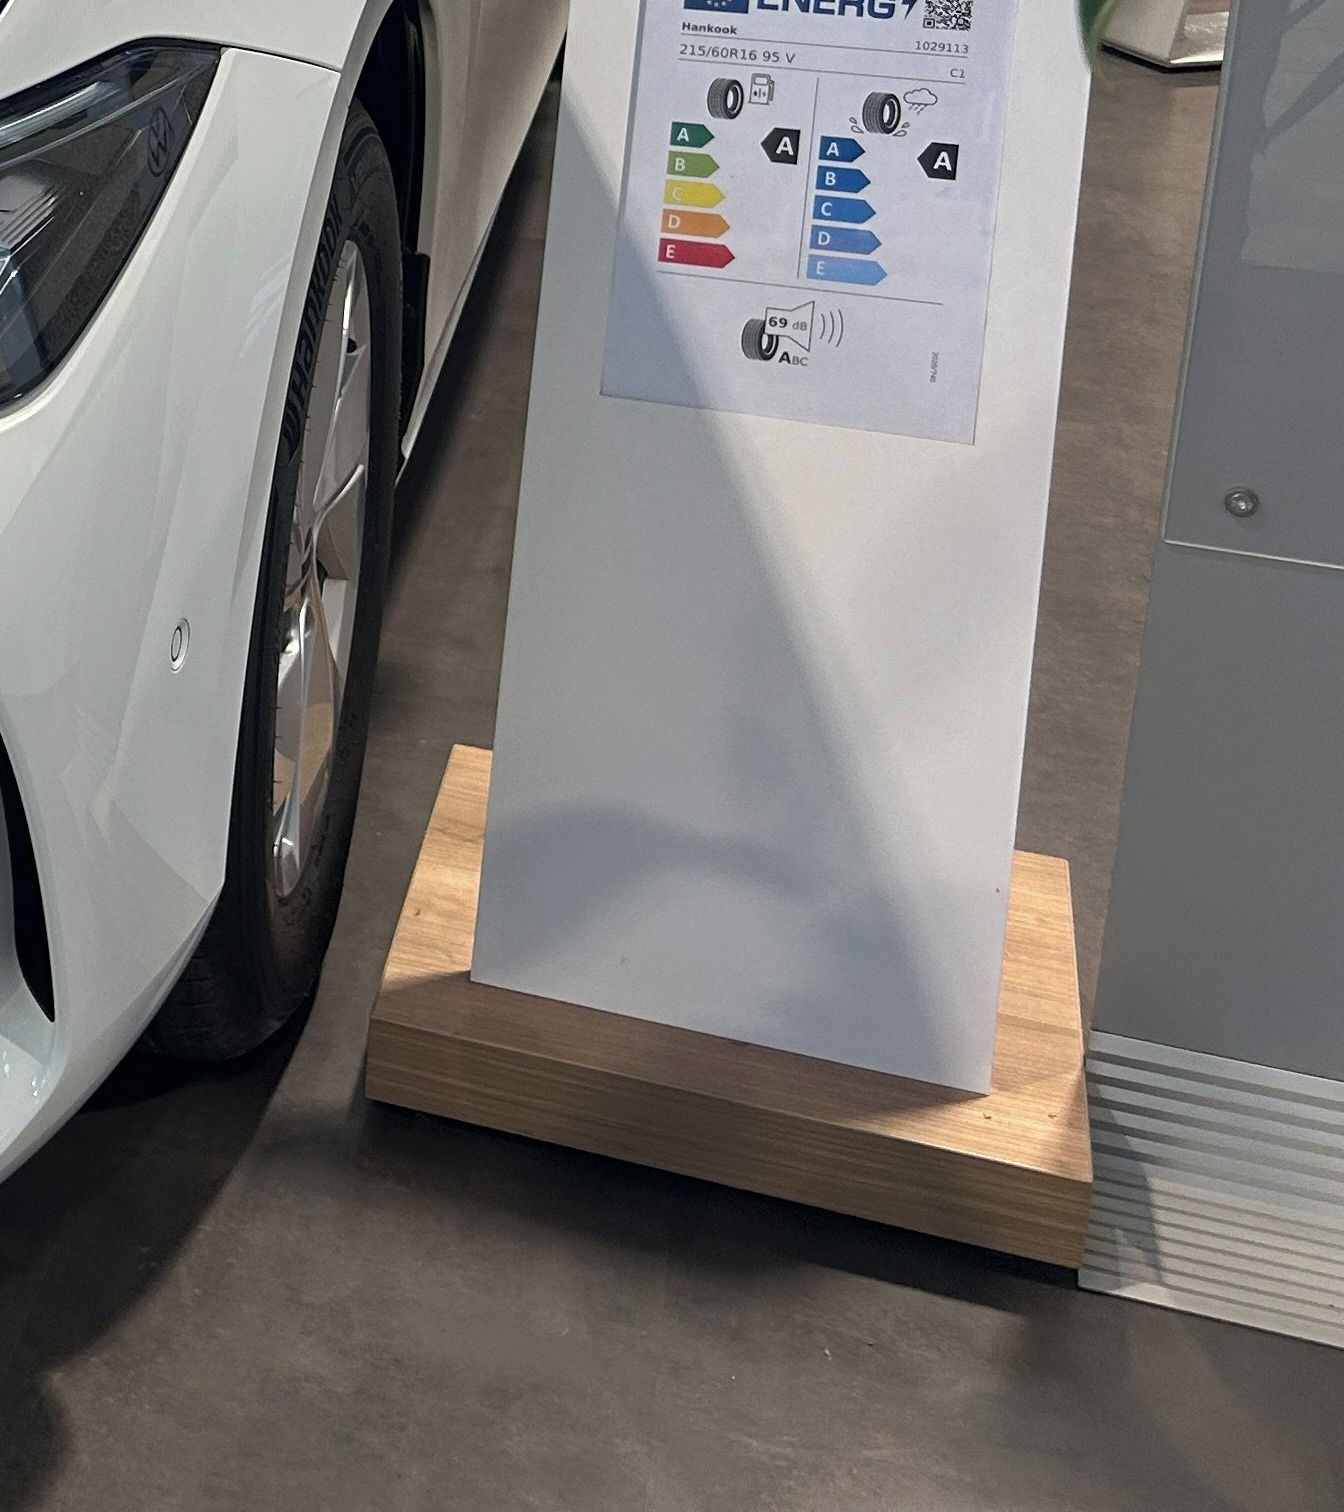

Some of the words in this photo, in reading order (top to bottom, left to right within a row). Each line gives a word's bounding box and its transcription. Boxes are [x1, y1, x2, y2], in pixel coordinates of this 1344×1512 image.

[681, 21, 737, 35] Hankook
[679, 44, 758, 61] 215/60R16
[762, 51, 780, 63] 95
[785, 53, 796, 64] V
[915, 40, 969, 54] 1029113
[950, 68, 966, 79] C1
[676, 127, 690, 141] A
[775, 137, 794, 156] A
[826, 142, 839, 157] A
[674, 158, 686, 171] B
[933, 151, 952, 172] A
[825, 172, 836, 186] B
[672, 187, 683, 201] C
[821, 202, 832, 216] C
[668, 216, 680, 229] D
[818, 232, 830, 246] D
[665, 245, 676, 259] E
[816, 262, 825, 275] E
[768, 316, 788, 328] 69
[792, 321, 808, 331] dB
